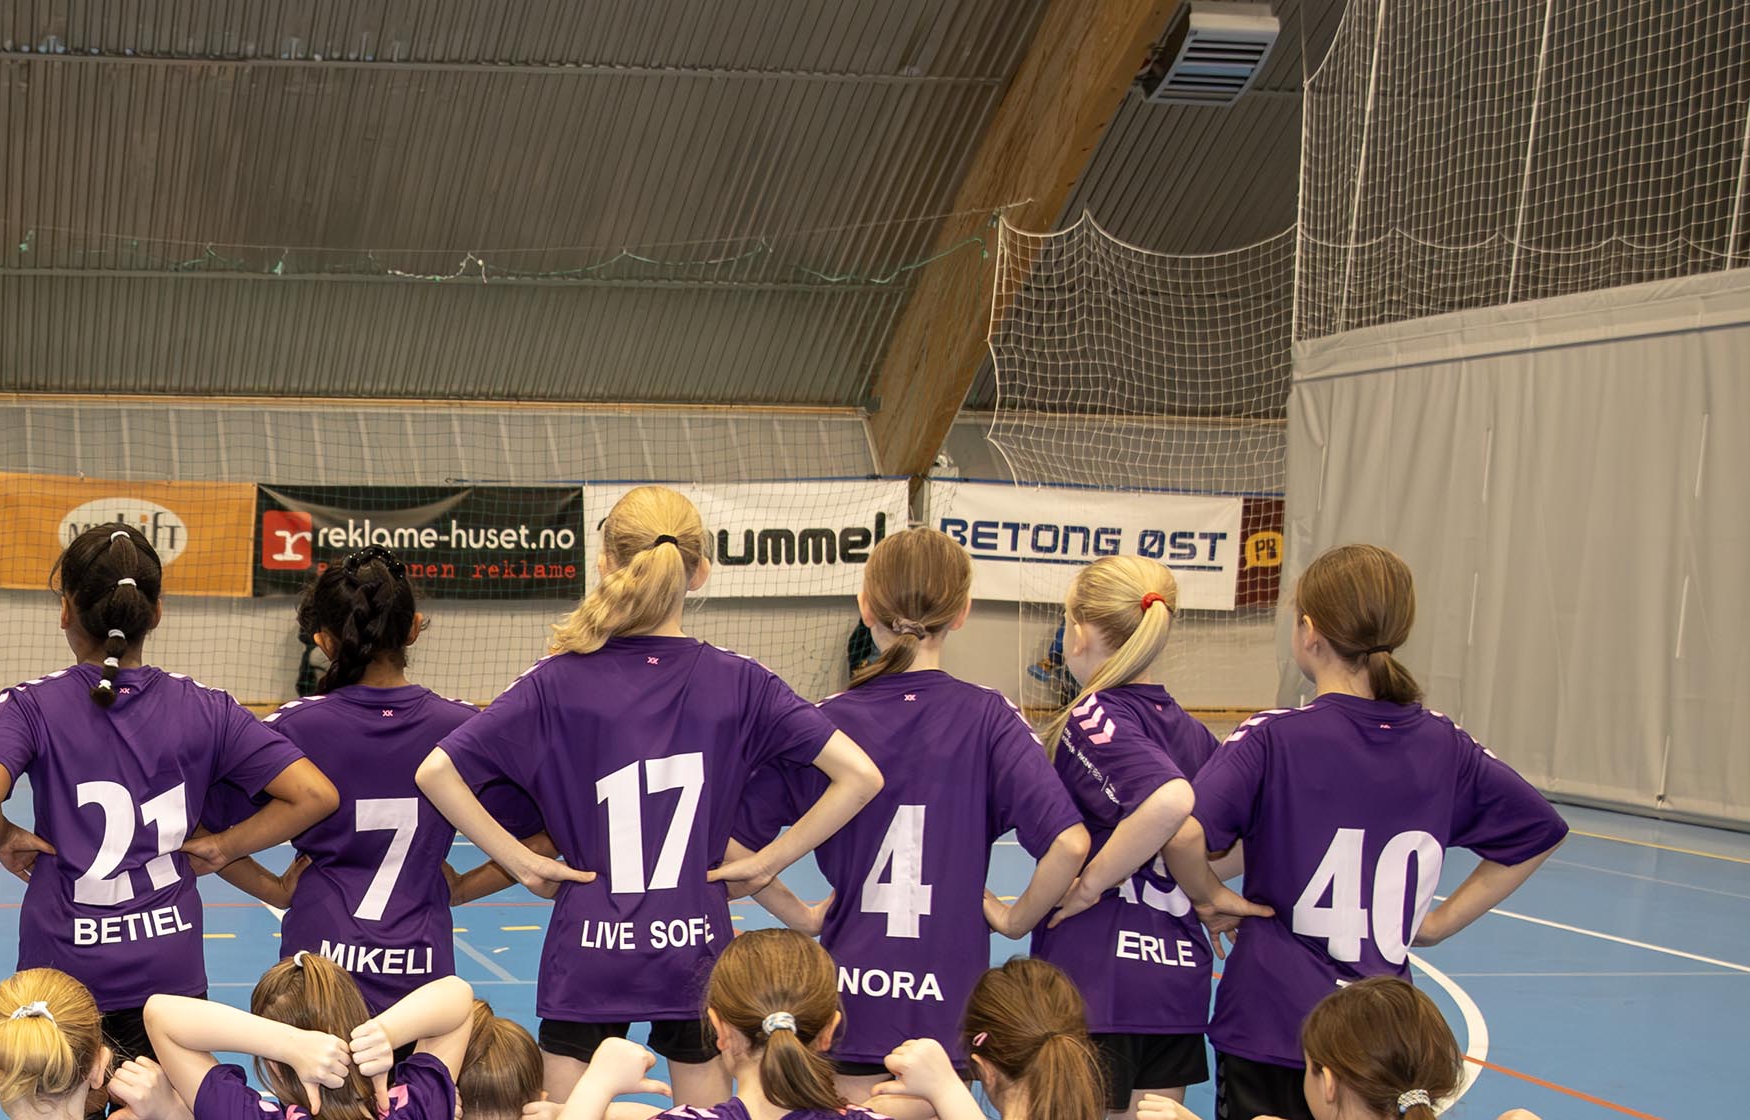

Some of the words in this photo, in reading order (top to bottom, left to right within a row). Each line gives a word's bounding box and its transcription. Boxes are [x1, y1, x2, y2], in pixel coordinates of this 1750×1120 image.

[318, 519, 576, 549] reklame-huset.no
[707, 511, 886, 566] ummel
[940, 518, 1123, 556] BETONG
[1139, 529, 1228, 562] ØST
[473, 561, 576, 578] reklame
[73, 780, 188, 906] 21
[595, 751, 705, 894] 17
[353, 797, 419, 921] 7
[860, 804, 933, 939] 4
[1292, 827, 1443, 965] 40
[73, 904, 193, 945] BETIEL
[580, 919, 636, 950] LIVE
[319, 939, 433, 975] MIKELI
[1116, 930, 1197, 968] ERLE
[837, 966, 944, 1001] NORA
